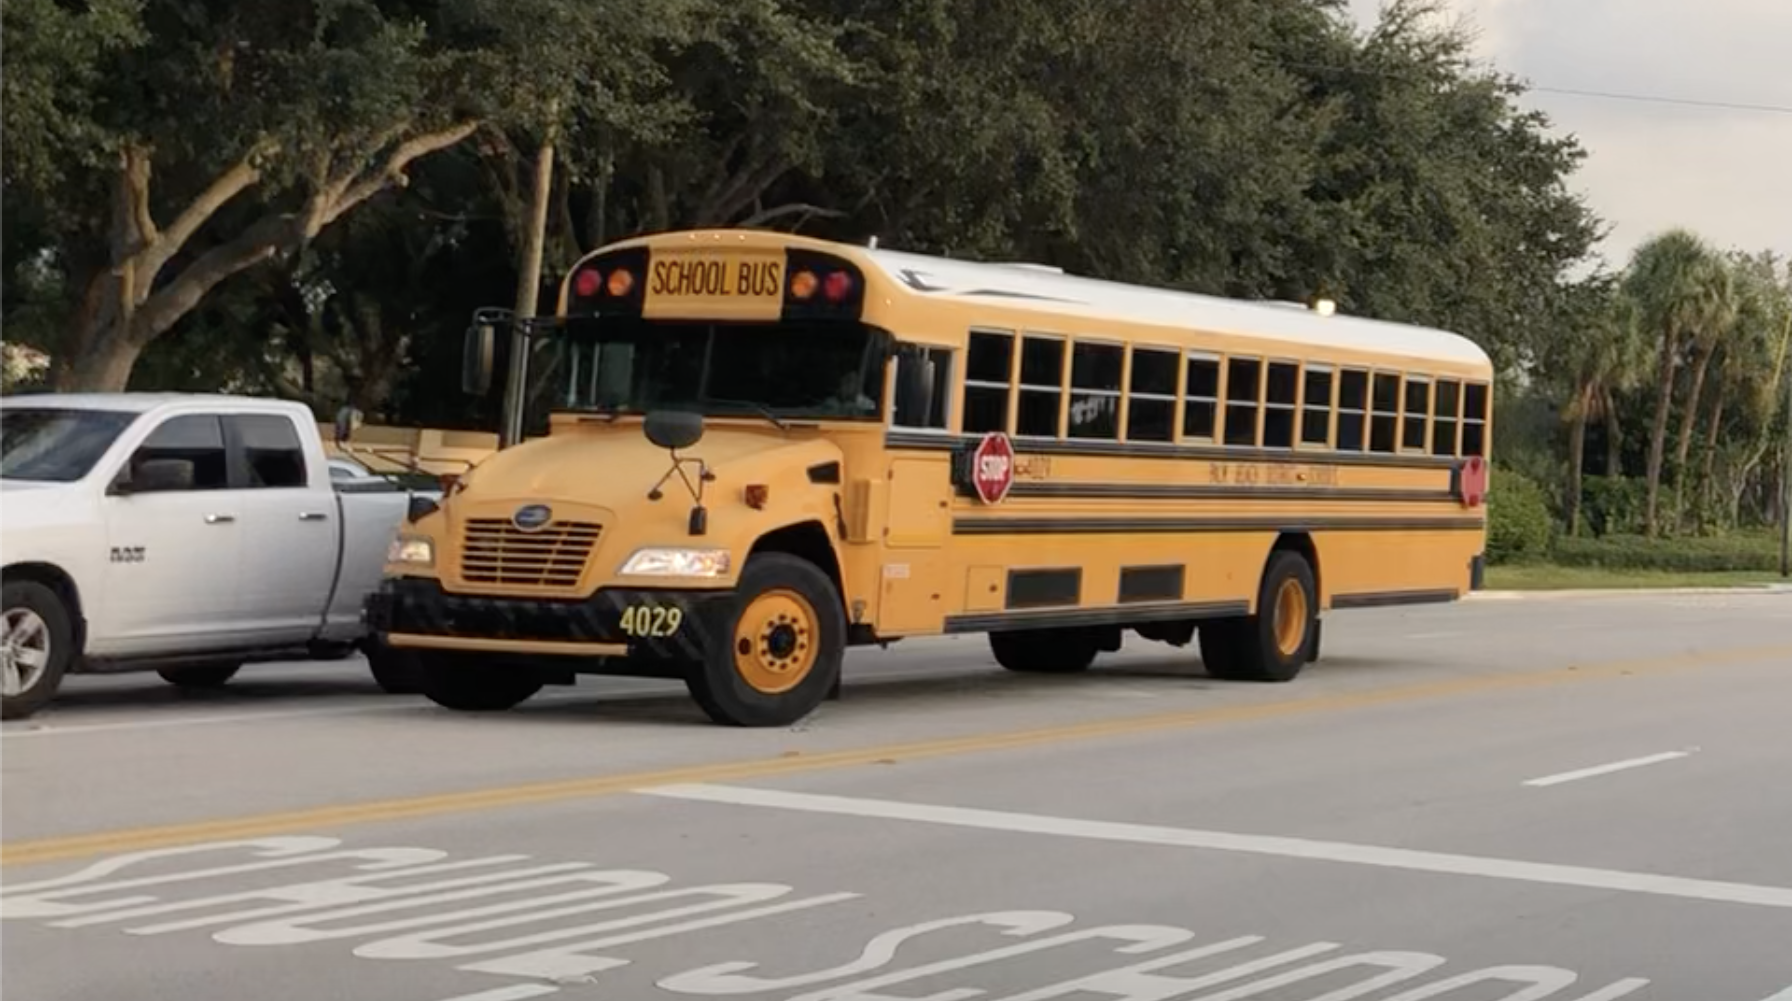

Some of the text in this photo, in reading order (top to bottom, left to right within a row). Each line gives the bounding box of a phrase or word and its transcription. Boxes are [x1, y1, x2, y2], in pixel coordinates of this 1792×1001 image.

[652, 260, 780, 296] SCHOOL BUS
[980, 454, 1010, 481] STOP
[619, 605, 683, 637] 4029
[654, 909, 1651, 1001] SCHO
